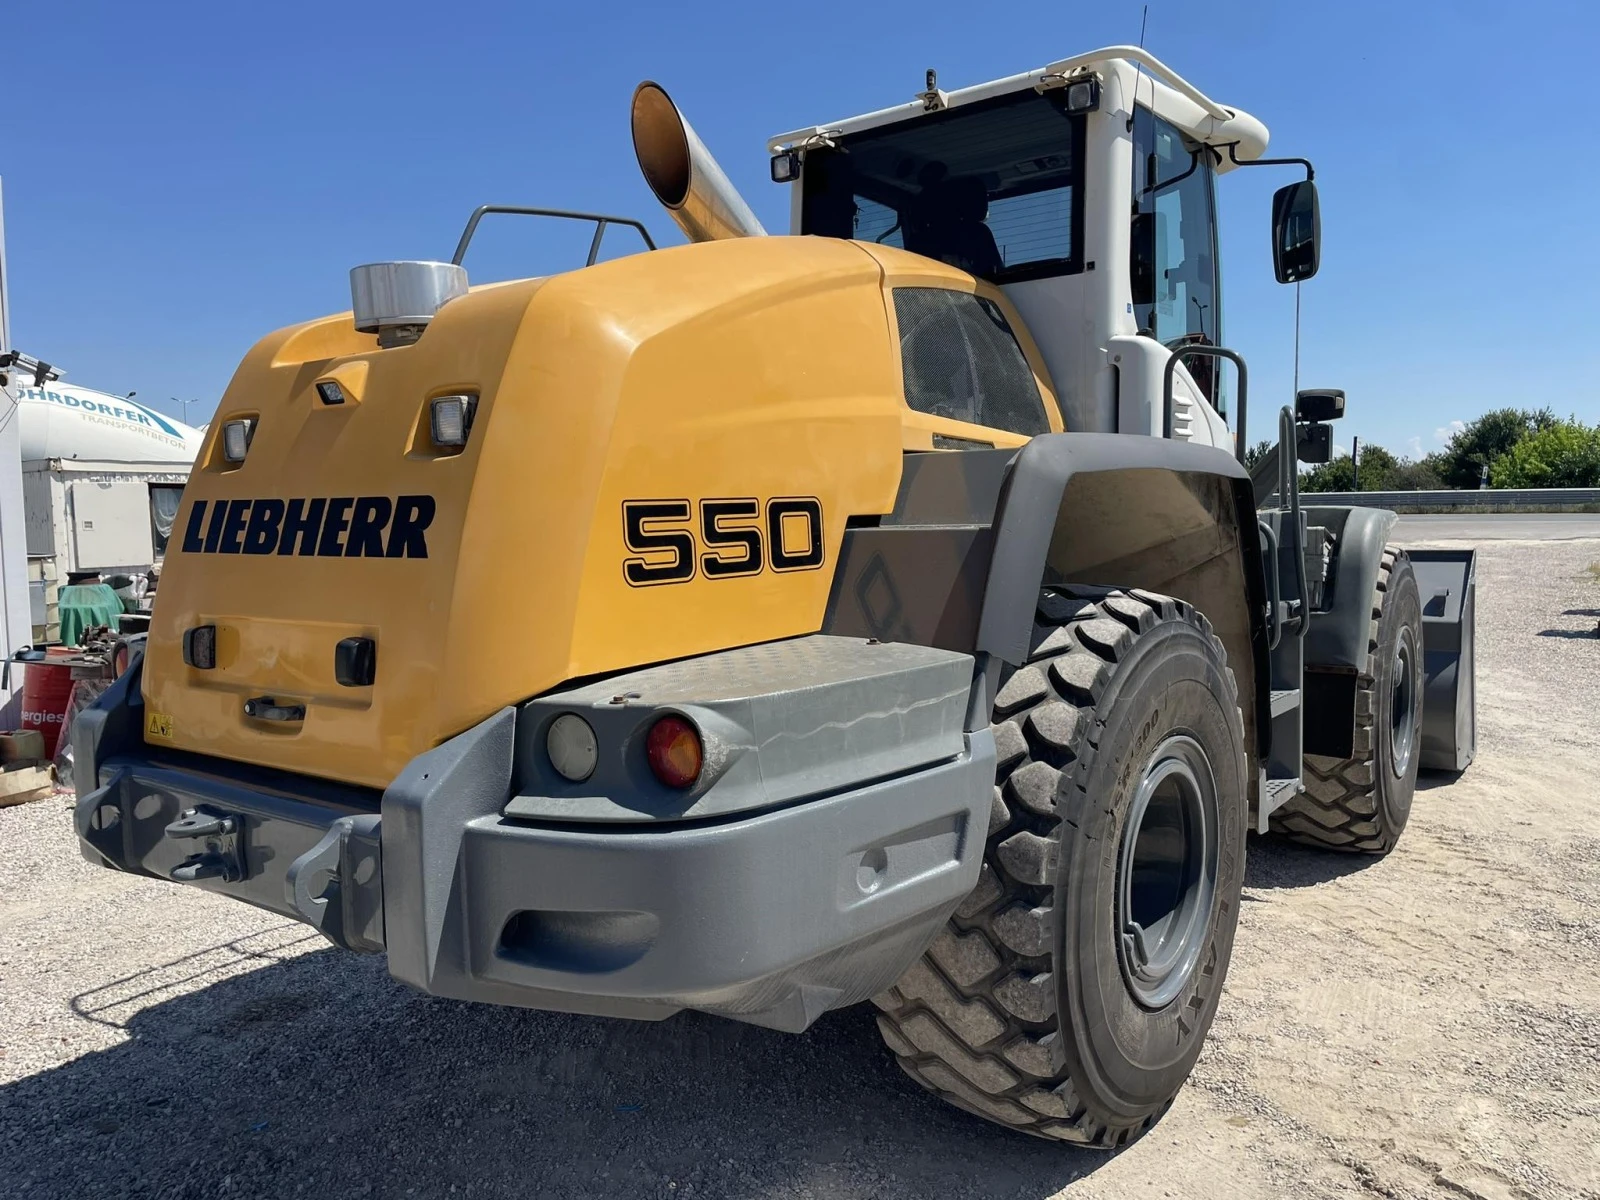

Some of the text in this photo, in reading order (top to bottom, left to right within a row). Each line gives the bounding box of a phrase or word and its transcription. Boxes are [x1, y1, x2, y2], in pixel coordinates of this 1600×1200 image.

[81, 413, 187, 451] TRANSPORTBETON
[181, 494, 437, 559] LIEBHERR
[621, 496, 826, 589] 550
